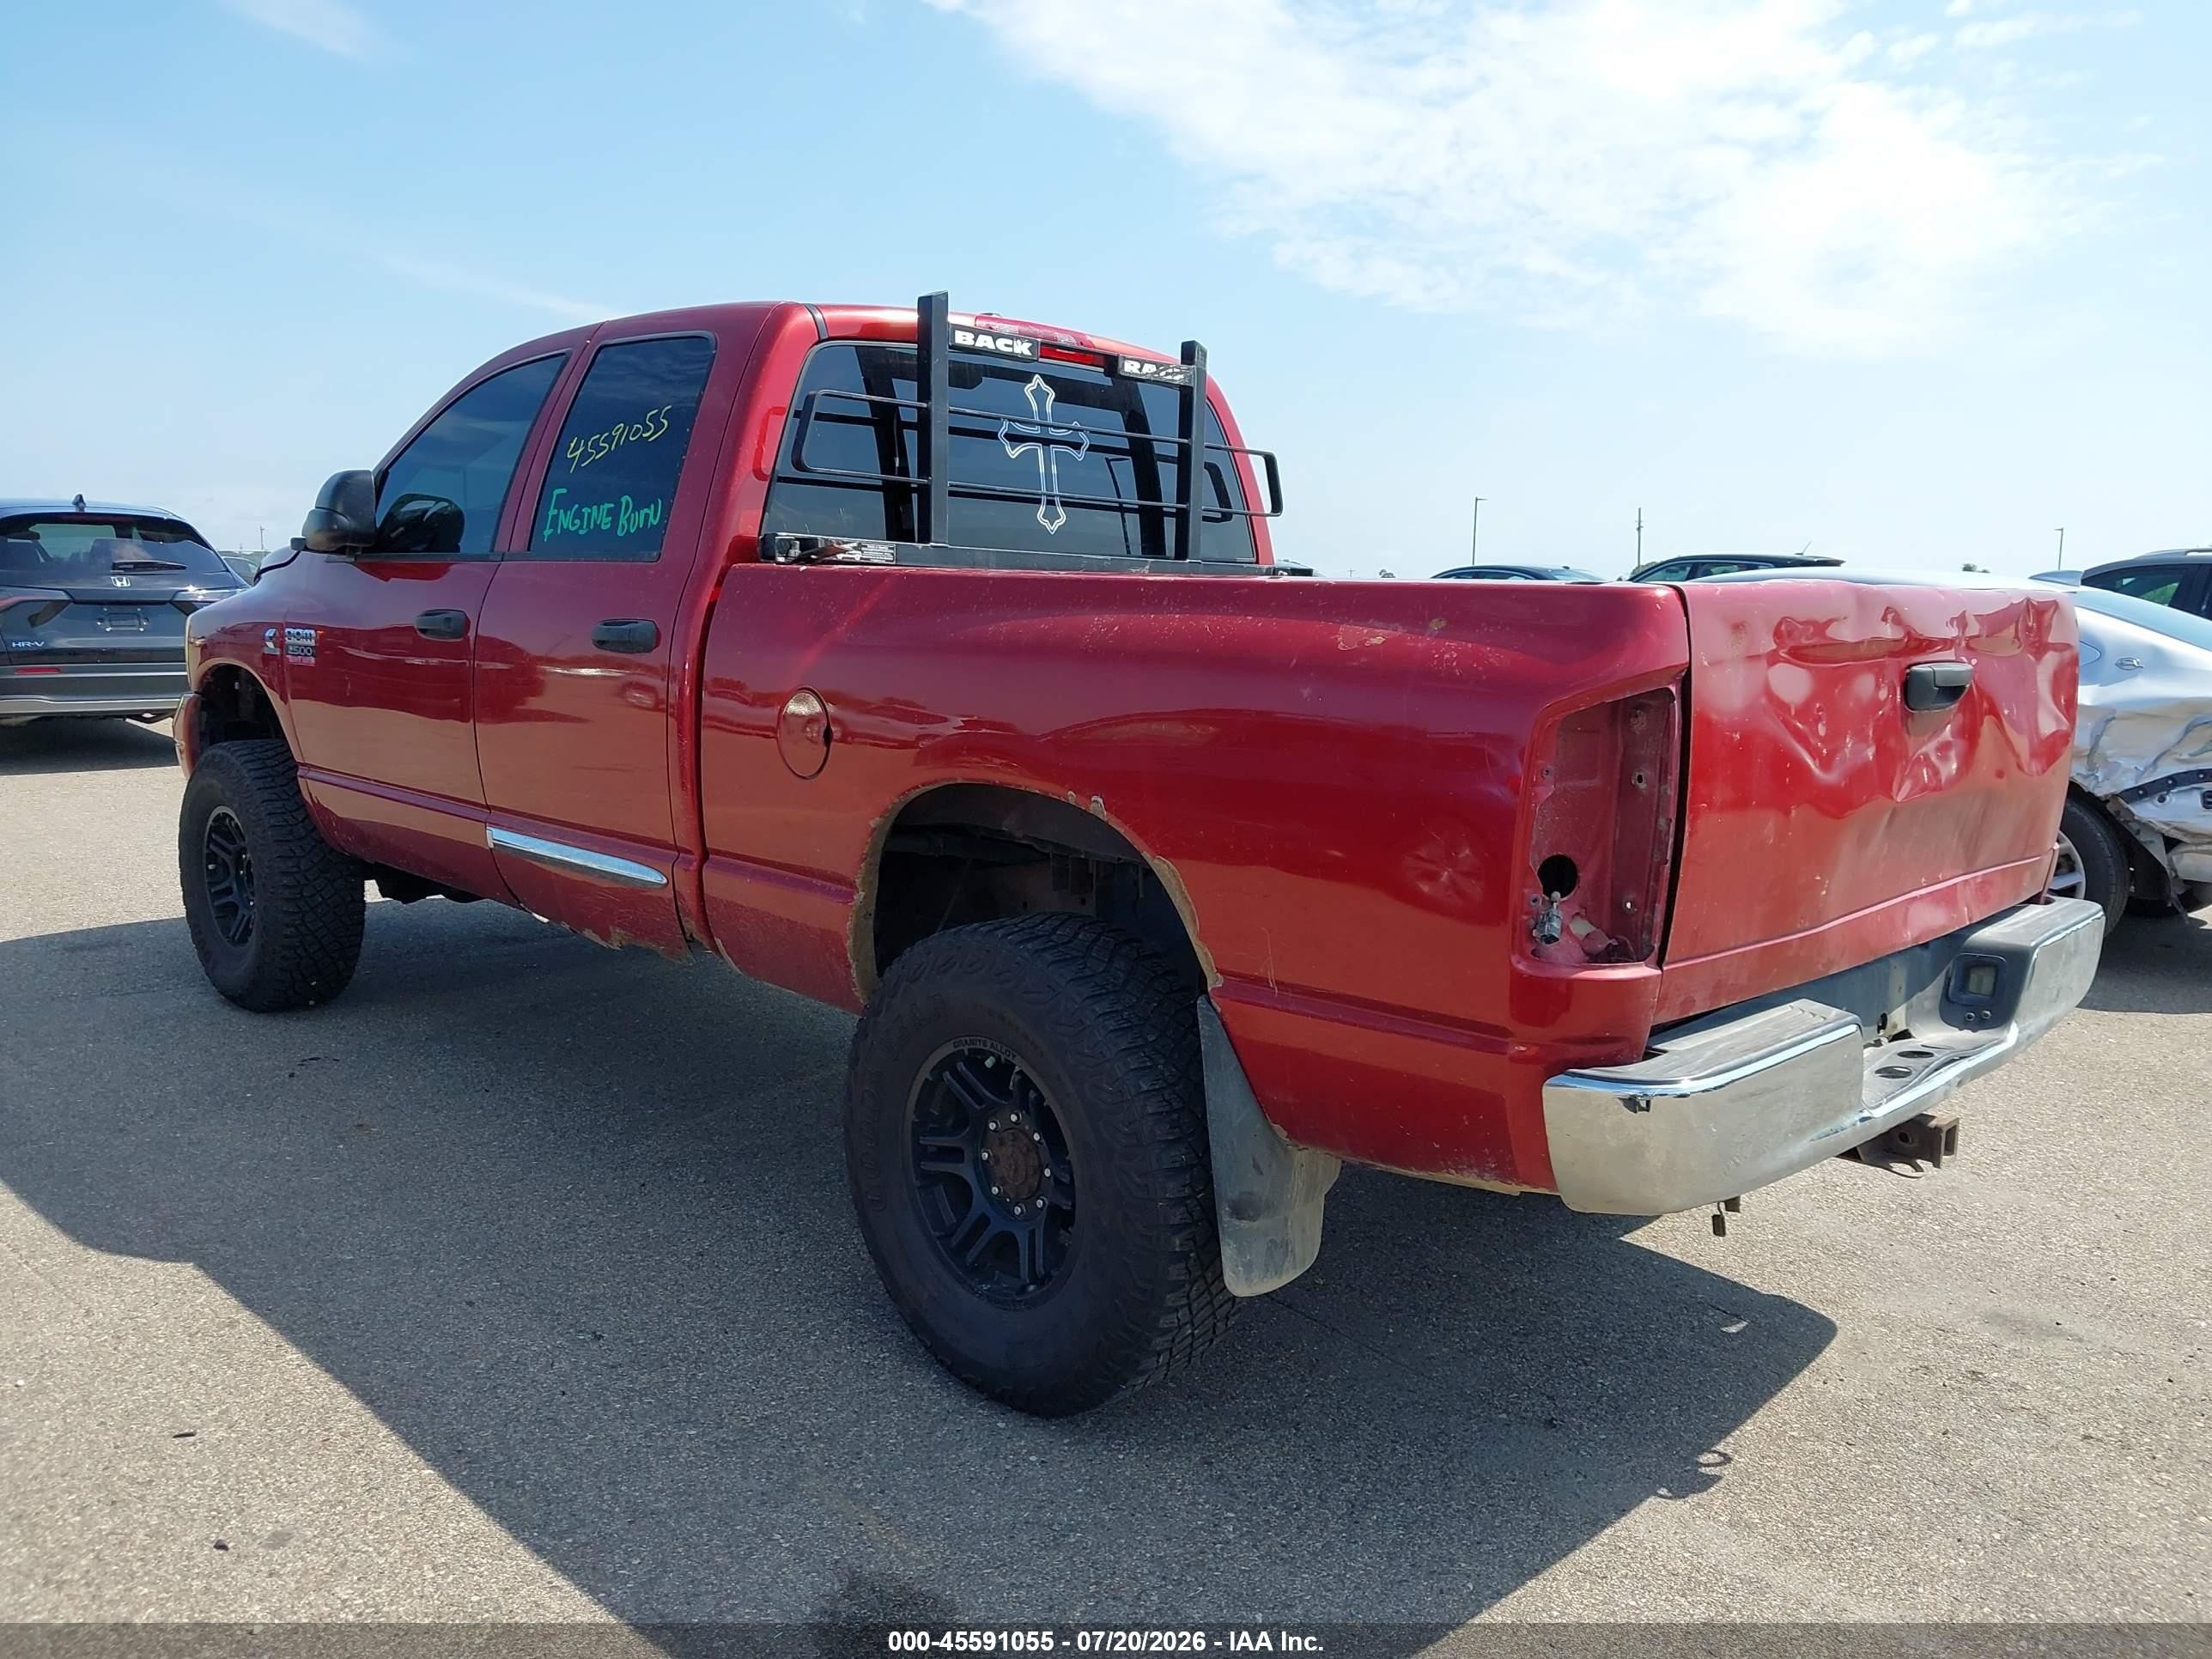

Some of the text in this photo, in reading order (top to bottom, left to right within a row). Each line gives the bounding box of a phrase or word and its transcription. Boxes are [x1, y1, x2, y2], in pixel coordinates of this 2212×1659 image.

[954, 330, 1032, 356] BACK
[567, 404, 672, 473] 45591055
[544, 488, 615, 543] ENGINE
